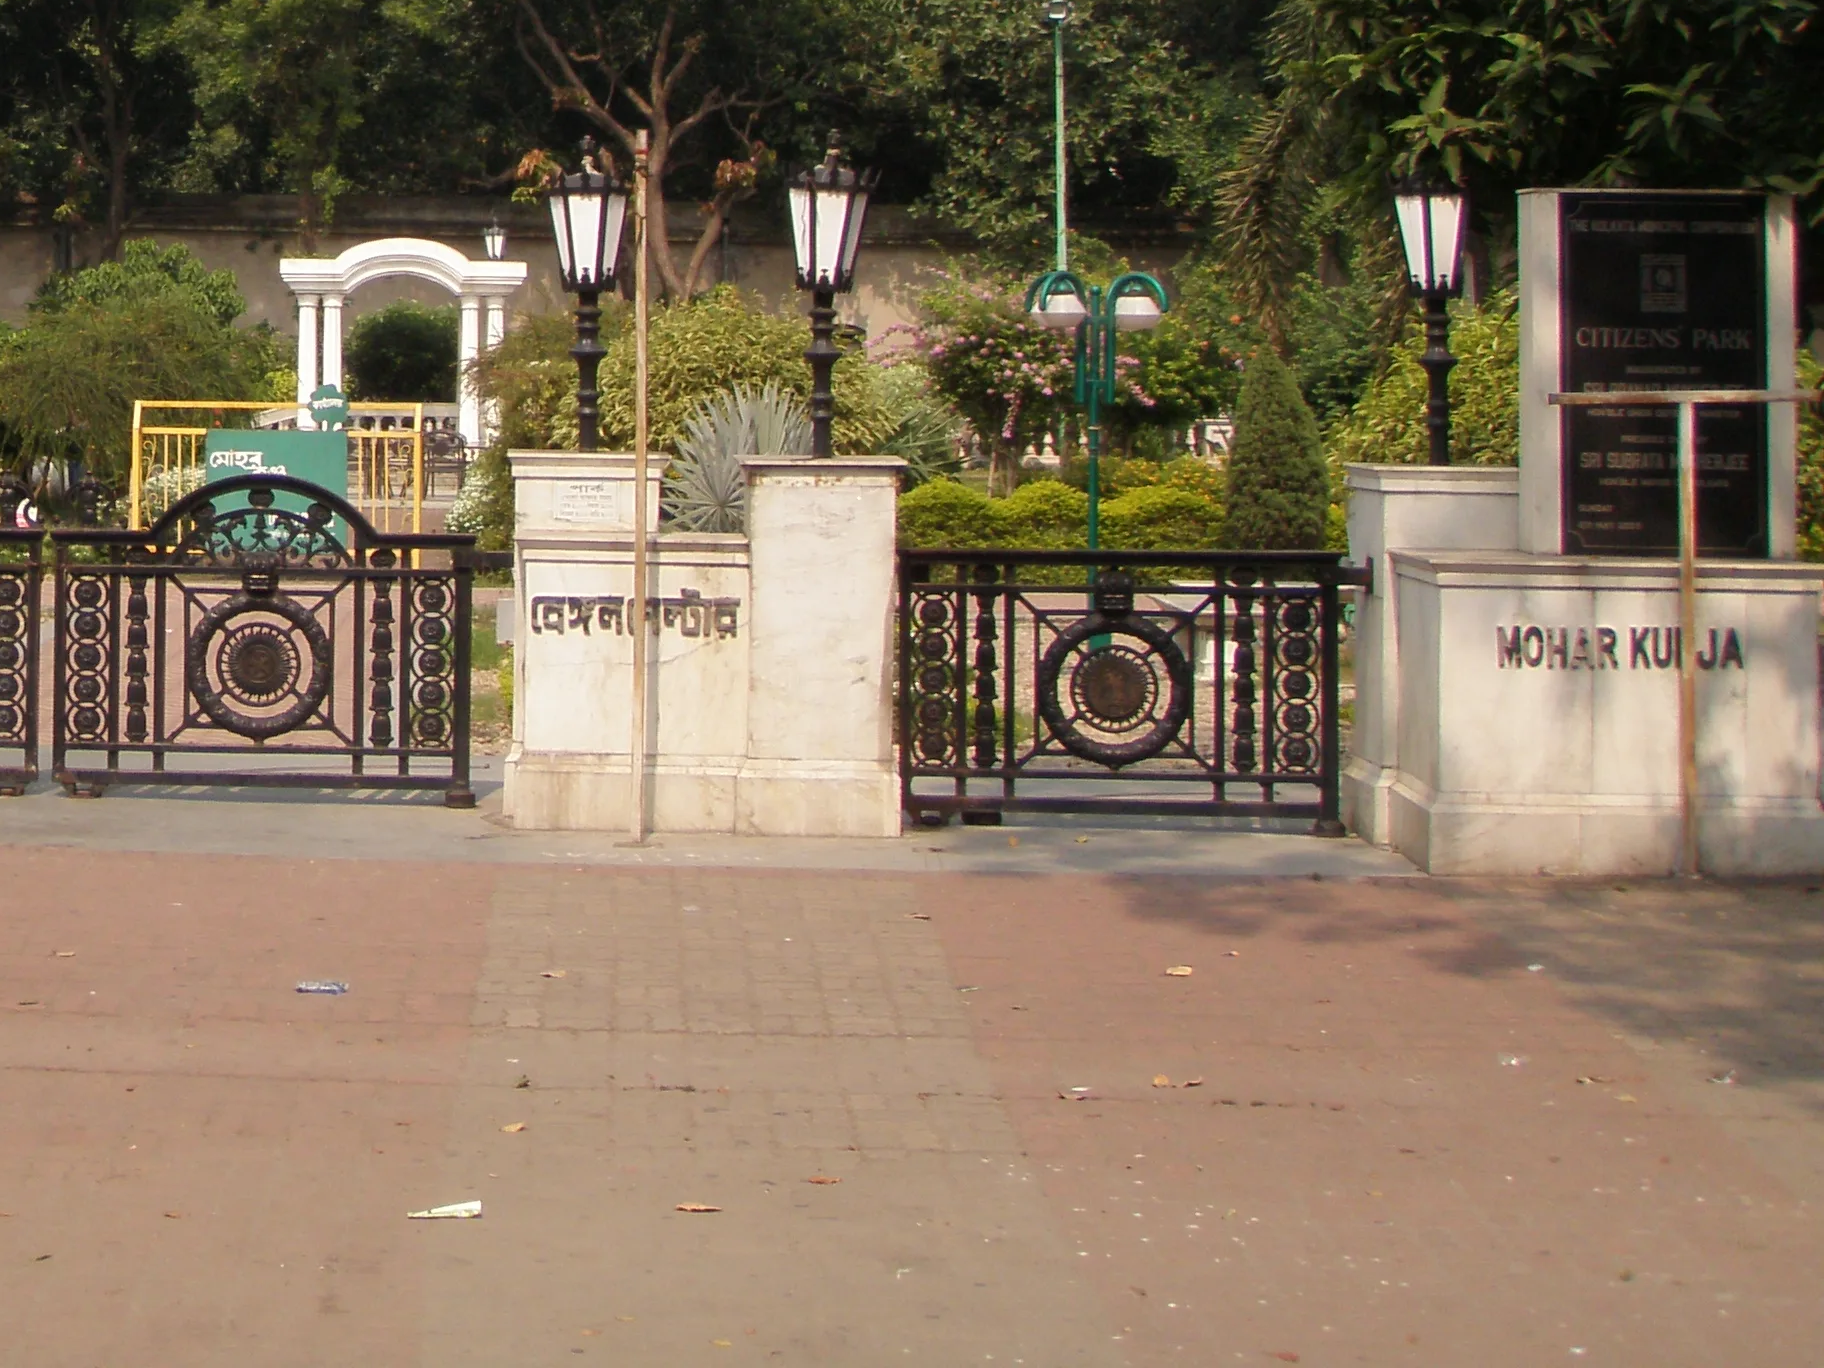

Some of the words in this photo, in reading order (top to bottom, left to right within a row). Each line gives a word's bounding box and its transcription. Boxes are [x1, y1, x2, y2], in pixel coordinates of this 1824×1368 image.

[1692, 328, 1750, 350] PARK
[1579, 451, 1602, 469] SRI
[1494, 624, 1619, 670] MOHAR
